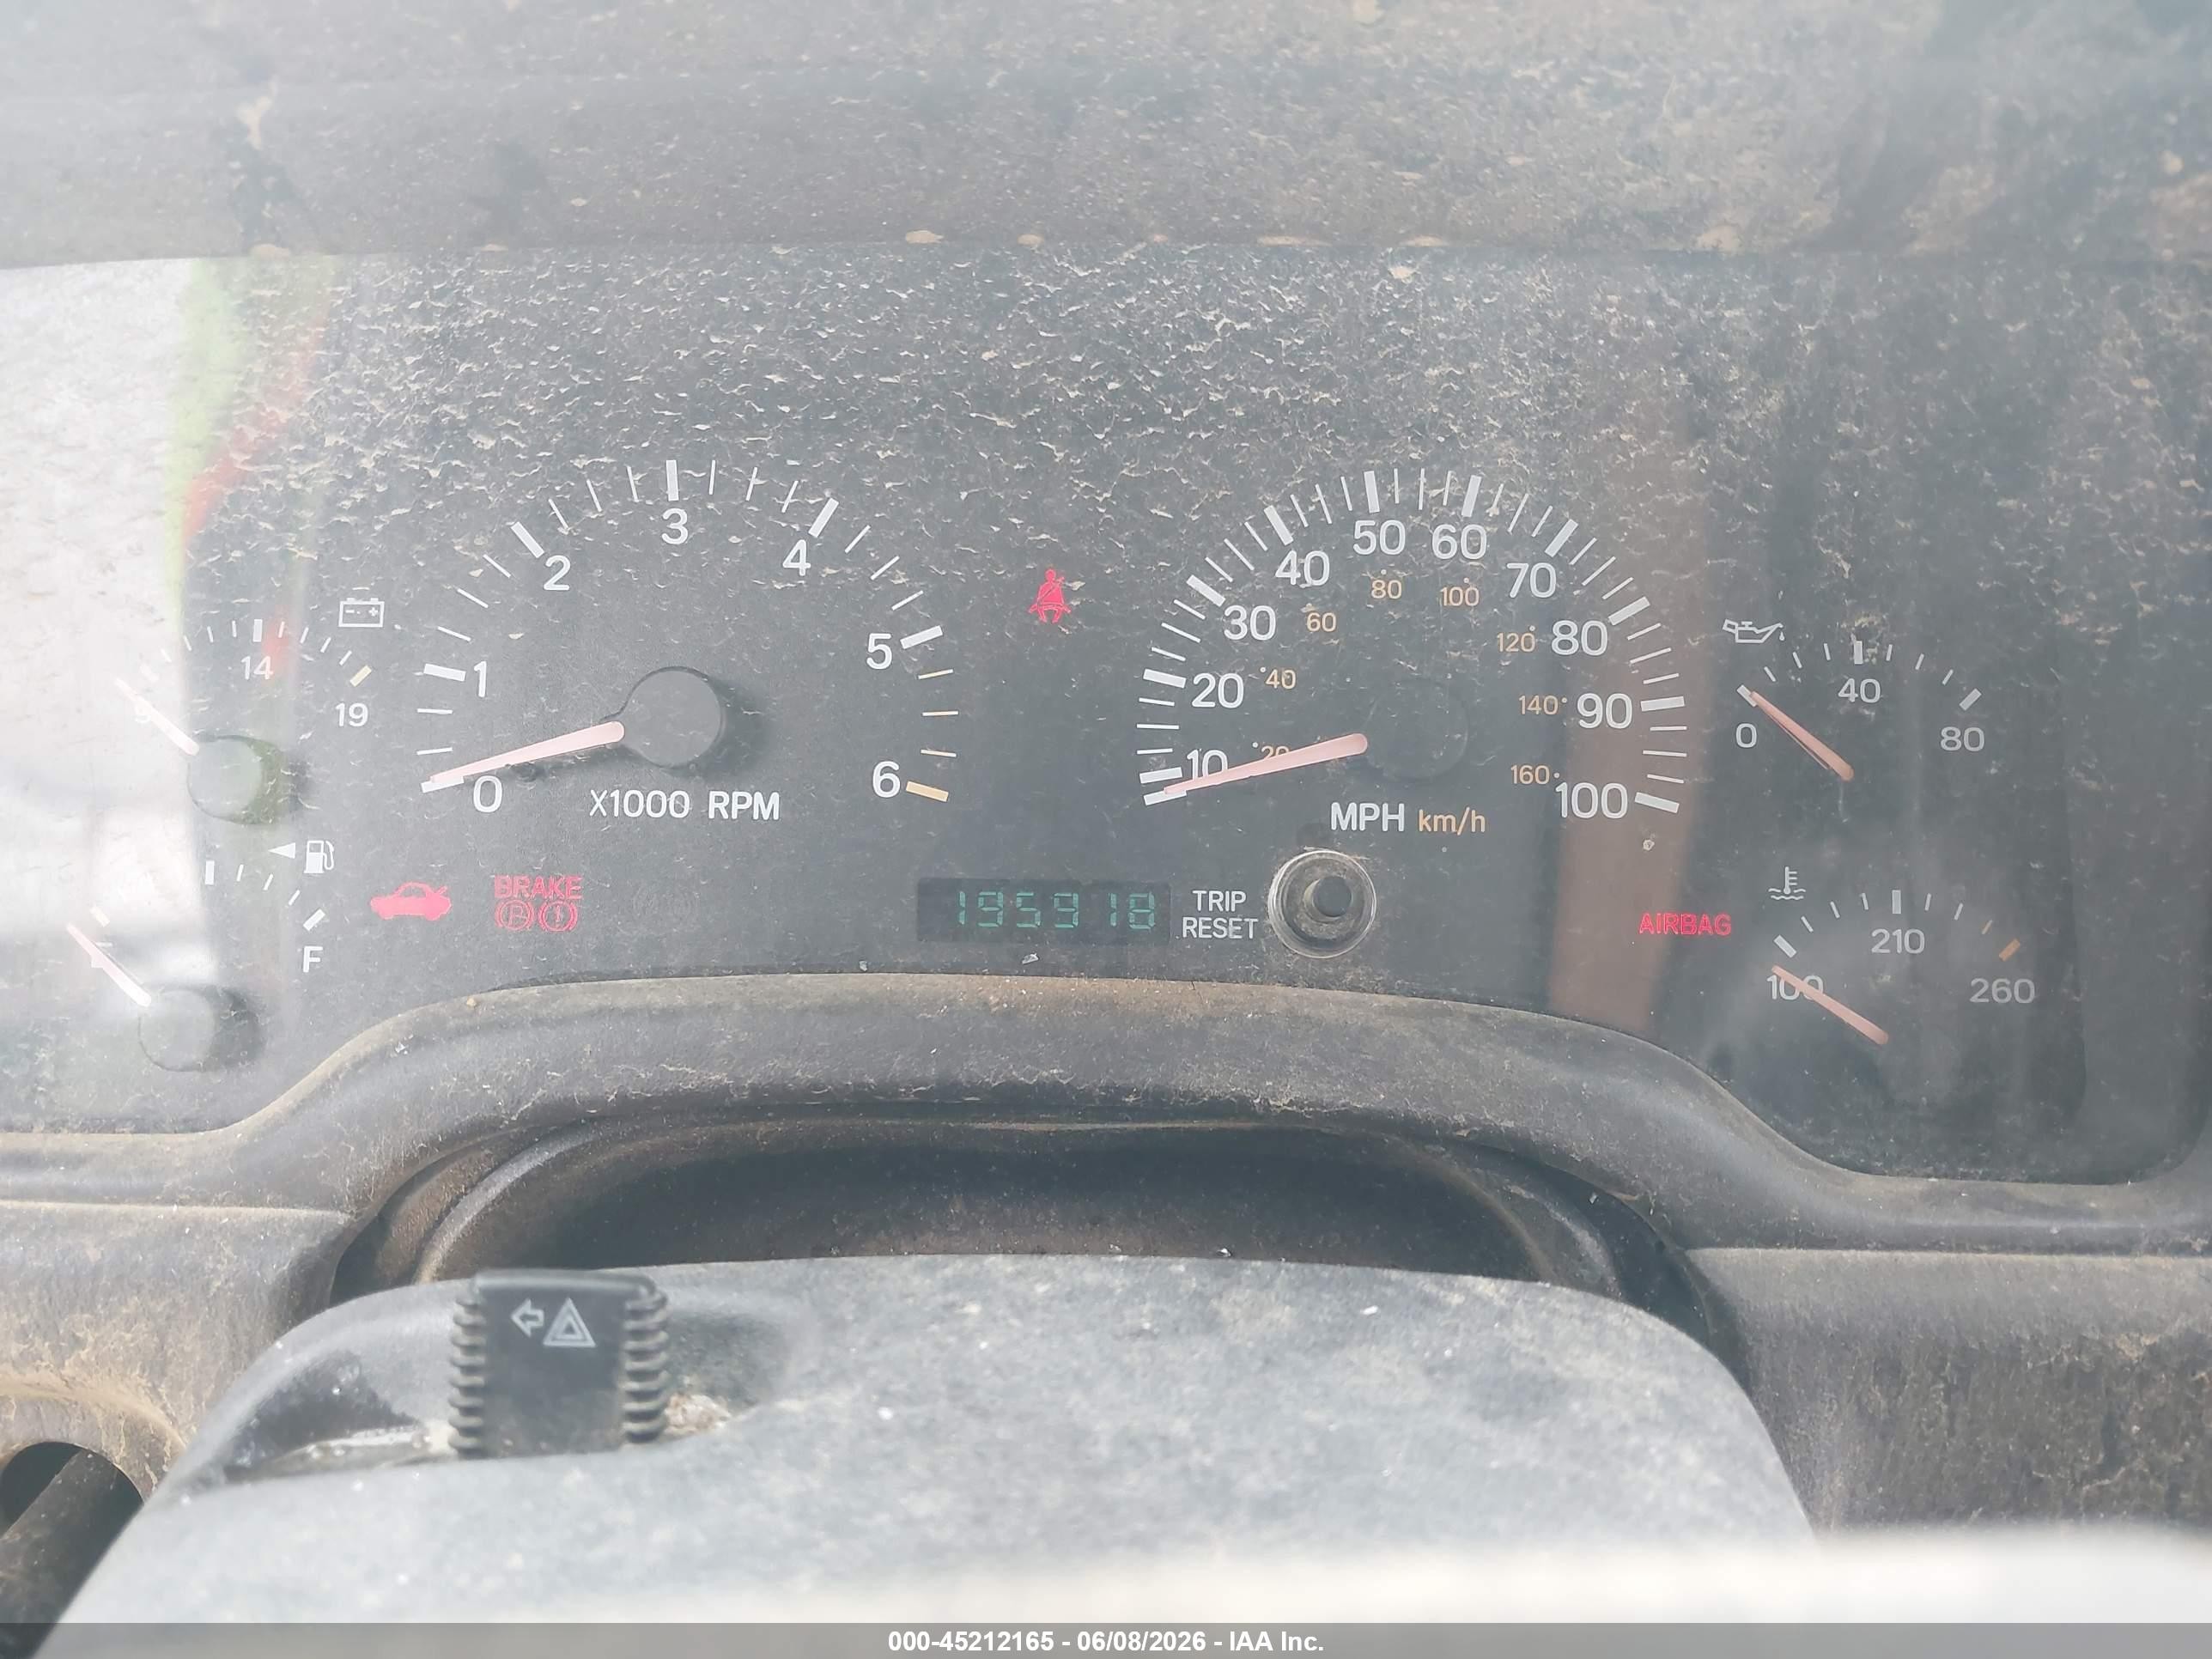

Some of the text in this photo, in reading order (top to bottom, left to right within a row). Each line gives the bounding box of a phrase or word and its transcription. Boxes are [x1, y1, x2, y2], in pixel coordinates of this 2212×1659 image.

[662, 508, 688, 544] 3
[1352, 520, 1405, 556] 50
[1431, 524, 1487, 559] 60
[783, 541, 811, 576] 4
[1275, 550, 1330, 586] 40
[543, 555, 570, 591] 2
[1507, 562, 1557, 599] 70
[1371, 580, 1402, 599] 80
[1441, 587, 1480, 606] 100
[1224, 605, 1276, 641] 30
[1306, 612, 1336, 631] 60
[867, 634, 892, 670] 5
[1498, 633, 1535, 652] 120
[1551, 620, 1607, 656] 80
[241, 656, 273, 679] 14
[473, 661, 487, 697] 1
[1266, 670, 1297, 689] 40
[1192, 673, 1244, 708] 20
[1838, 678, 1881, 703] 40
[336, 703, 368, 727] 19
[1519, 696, 1559, 715] 140
[1577, 693, 1632, 728] 90
[1735, 723, 1757, 748] 0
[1940, 727, 1984, 751] 80
[1187, 750, 1228, 781] 10
[1510, 765, 1549, 785] 160
[473, 775, 502, 812] 0
[872, 762, 901, 798] 6
[589, 790, 780, 820] X1000 RPM
[1555, 782, 1627, 818] 100
[1330, 802, 1486, 835] MPH km/h
[494, 874, 583, 899] BRAKE
[957, 890, 1156, 930] 195918
[1192, 890, 1247, 912] TRIP
[1182, 916, 1258, 939] RESET
[1638, 913, 1732, 936] AIRBAG
[1871, 929, 1925, 954] 210
[303, 946, 323, 973] F
[1766, 975, 1824, 1000] 100
[1970, 978, 2035, 1004] 260
